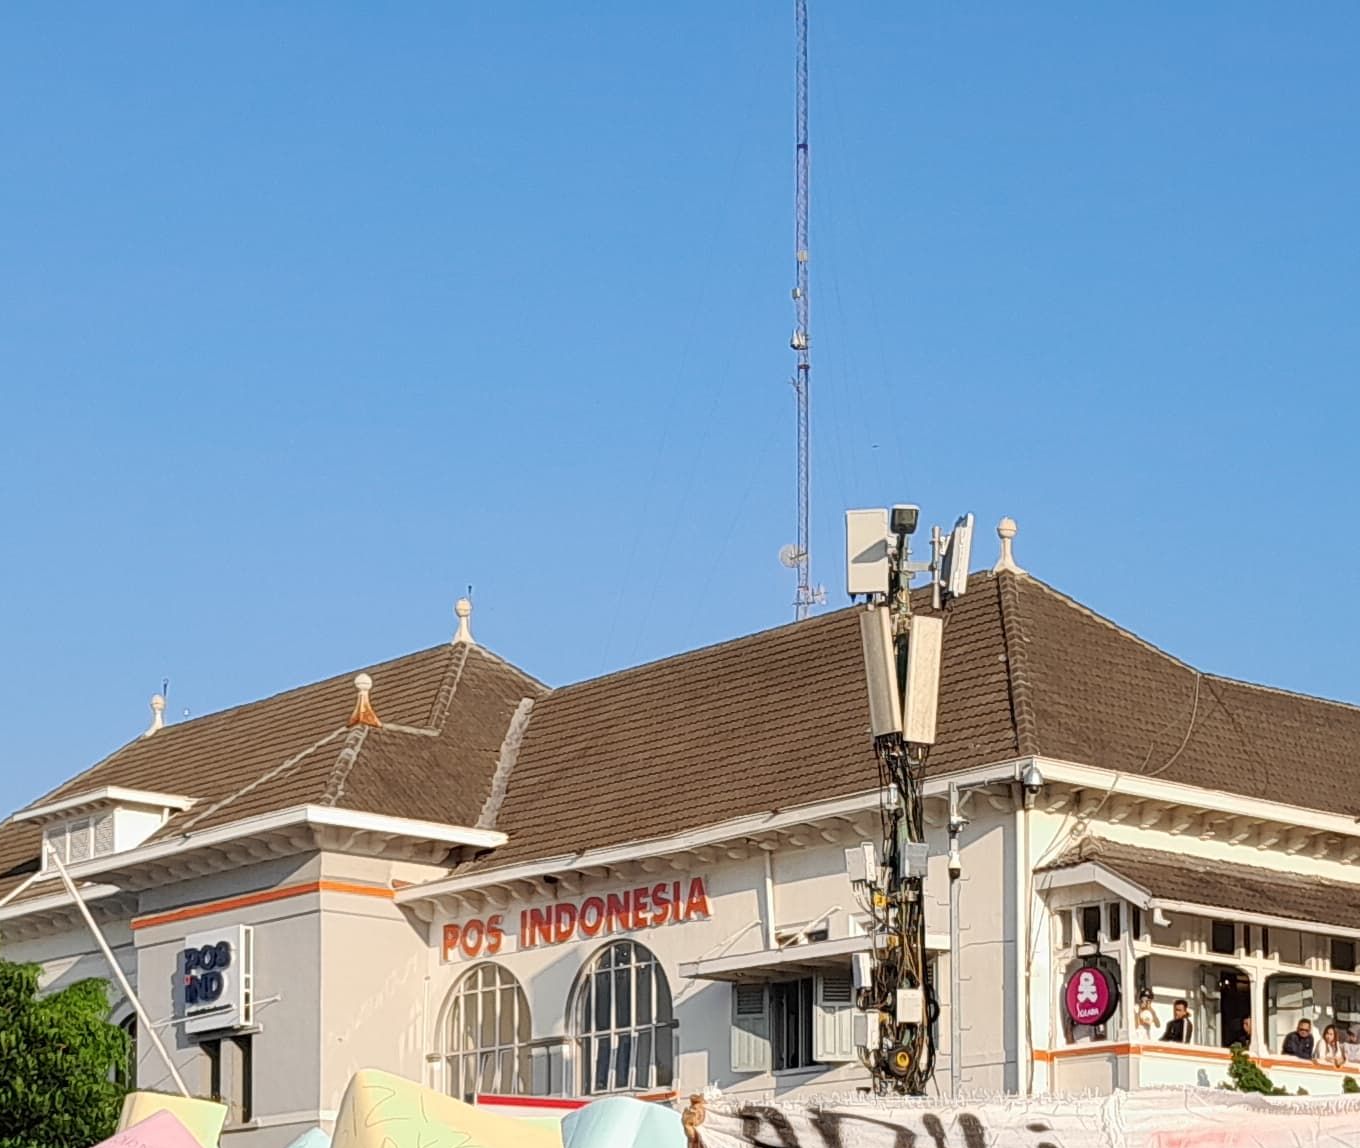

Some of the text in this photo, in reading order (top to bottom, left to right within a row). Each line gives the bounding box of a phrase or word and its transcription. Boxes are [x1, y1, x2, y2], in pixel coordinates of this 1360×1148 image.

[442, 876, 712, 960] POS INDONESIA
[184, 940, 232, 974] POS
